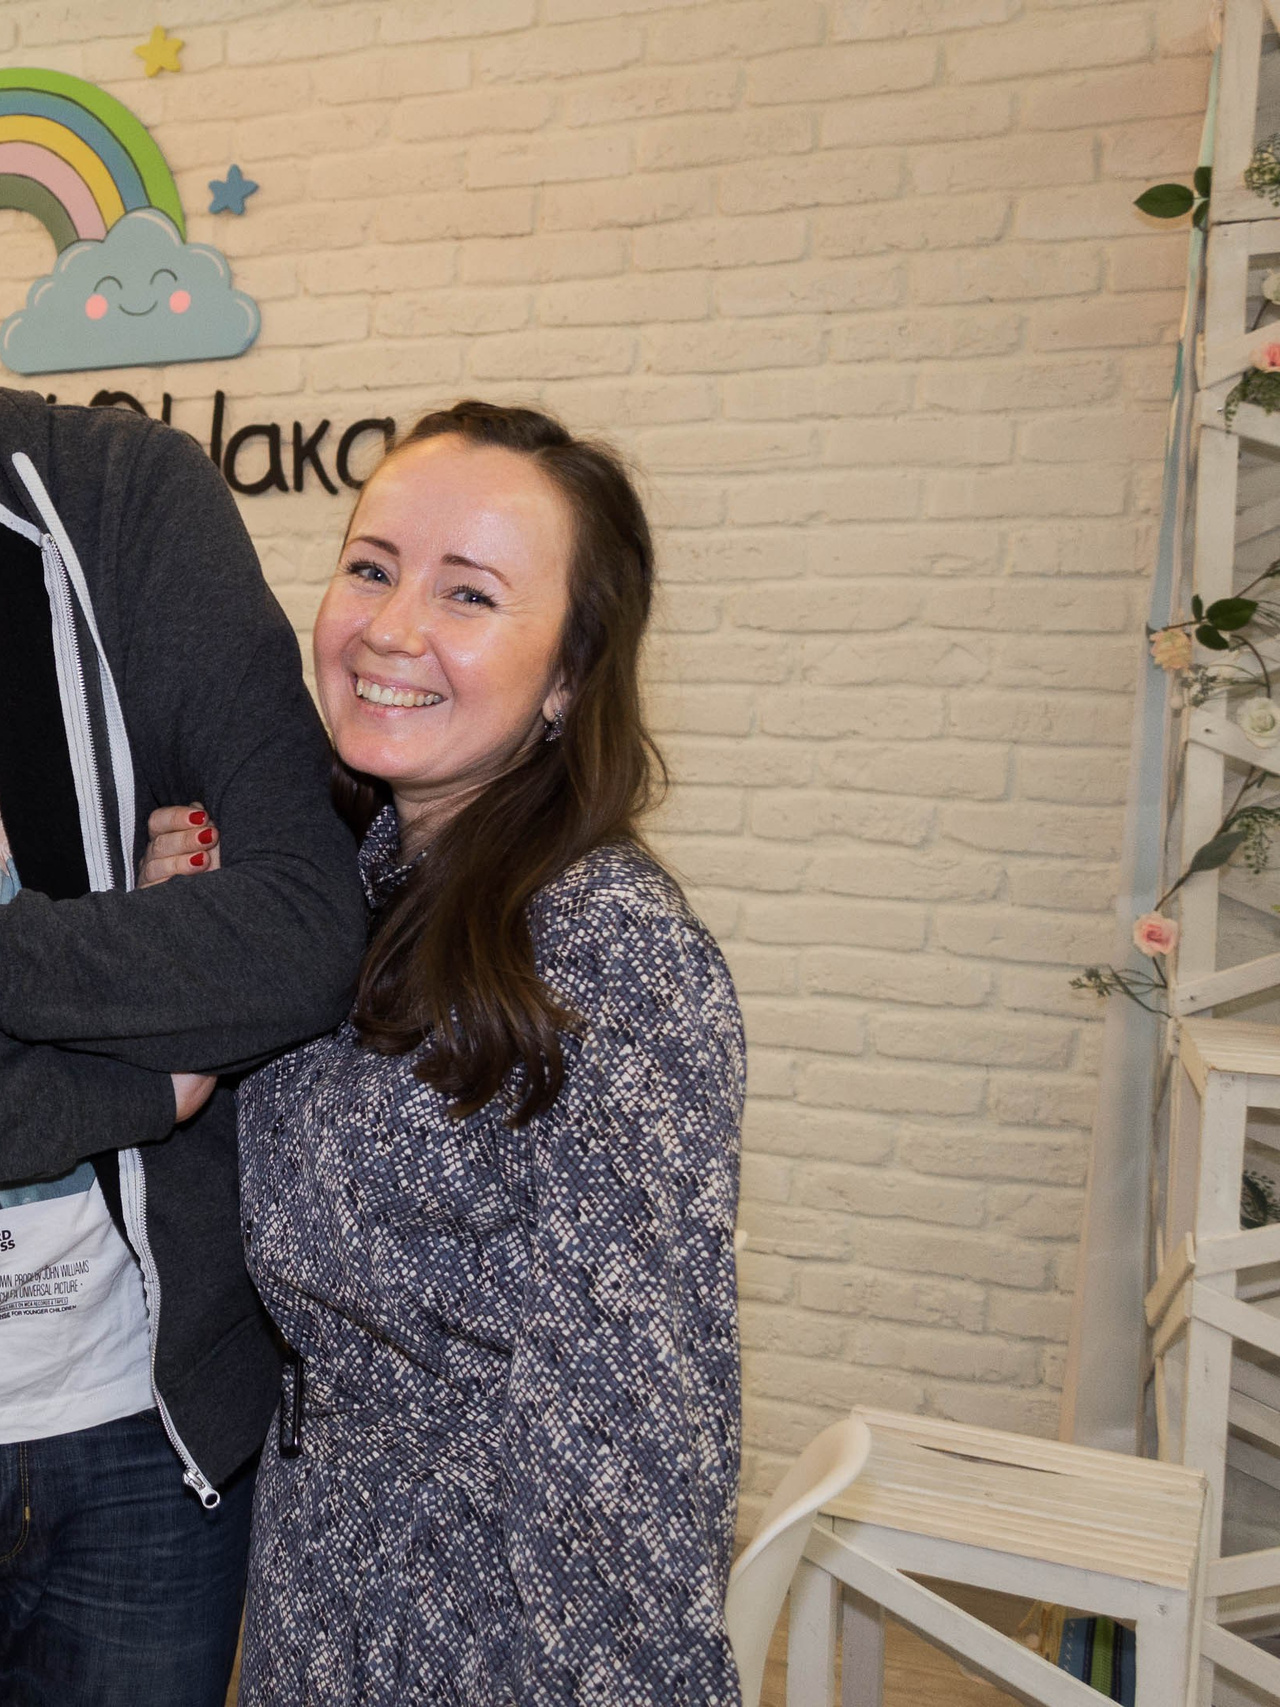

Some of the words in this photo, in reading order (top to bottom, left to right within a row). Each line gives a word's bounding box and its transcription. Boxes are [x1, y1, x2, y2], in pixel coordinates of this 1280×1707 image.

[42, 1266, 60, 1281] JOHN
[61, 1259, 90, 1278] WILLIAMS
[19, 1283, 52, 1299] UNIVERSAL
[53, 1279, 79, 1295] PICTURE
[23, 1308, 48, 1316] YOUNGER
[49, 1305, 77, 1314] CHILDREN
